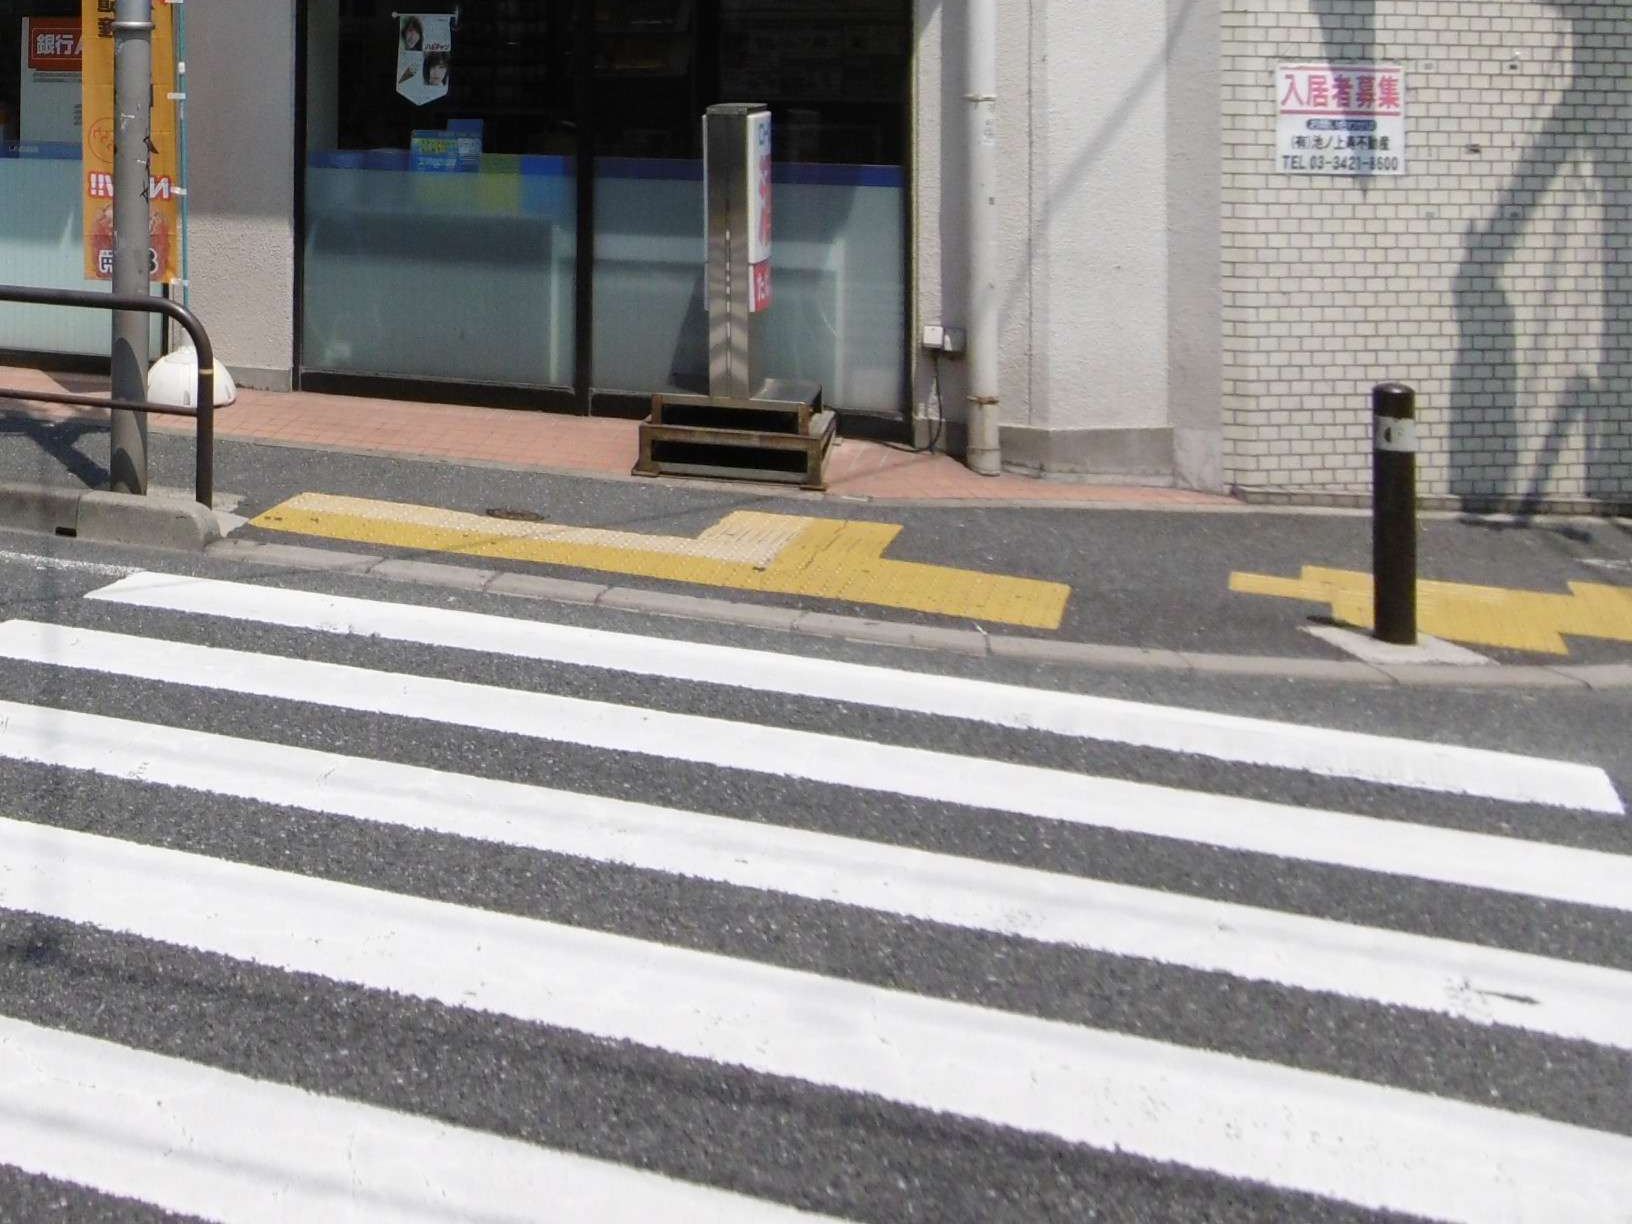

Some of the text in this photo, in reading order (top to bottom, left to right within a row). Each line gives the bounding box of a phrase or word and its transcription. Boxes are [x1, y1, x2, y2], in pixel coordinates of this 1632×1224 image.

[1280, 74, 1400, 109] 入居者募集
[1282, 155, 1306, 170] TEL
